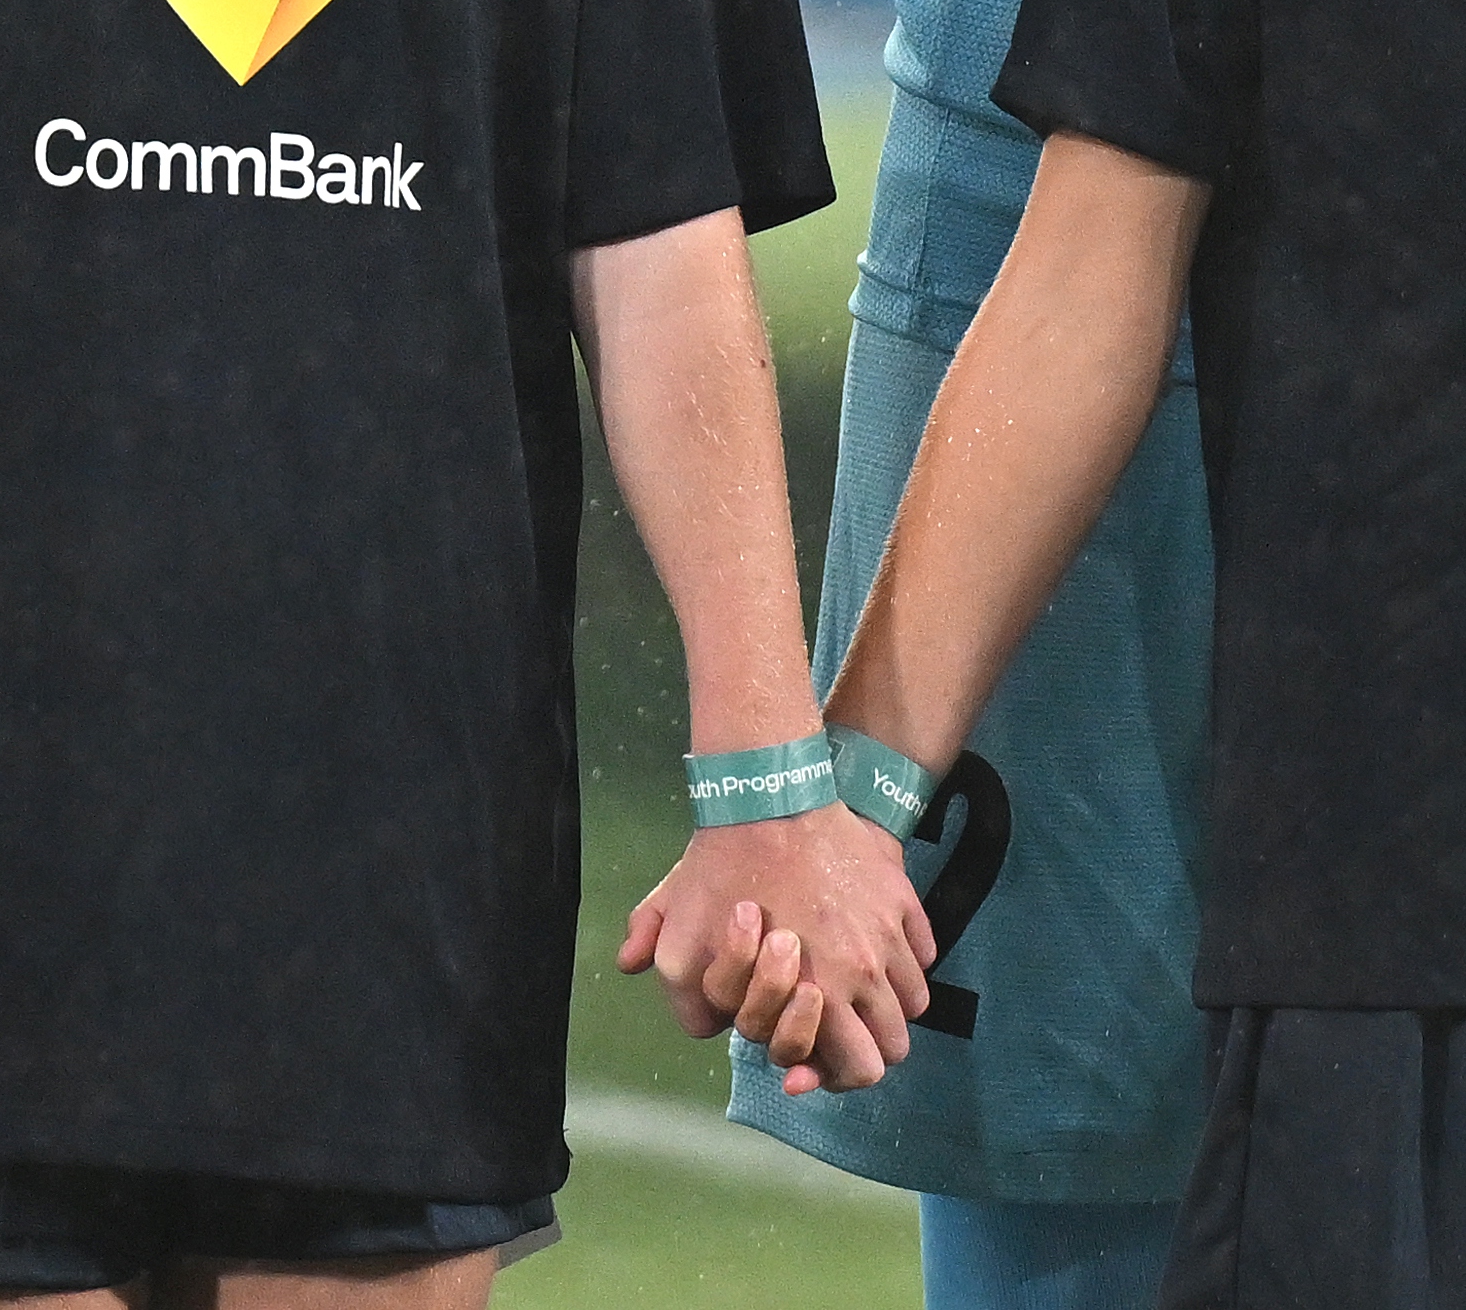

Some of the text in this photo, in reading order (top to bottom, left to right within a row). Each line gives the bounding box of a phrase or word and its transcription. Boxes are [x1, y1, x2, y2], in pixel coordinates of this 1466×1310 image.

[34, 118, 425, 211] CommBank
[873, 767, 922, 816] Youth
[907, 750, 1012, 1040] 2
